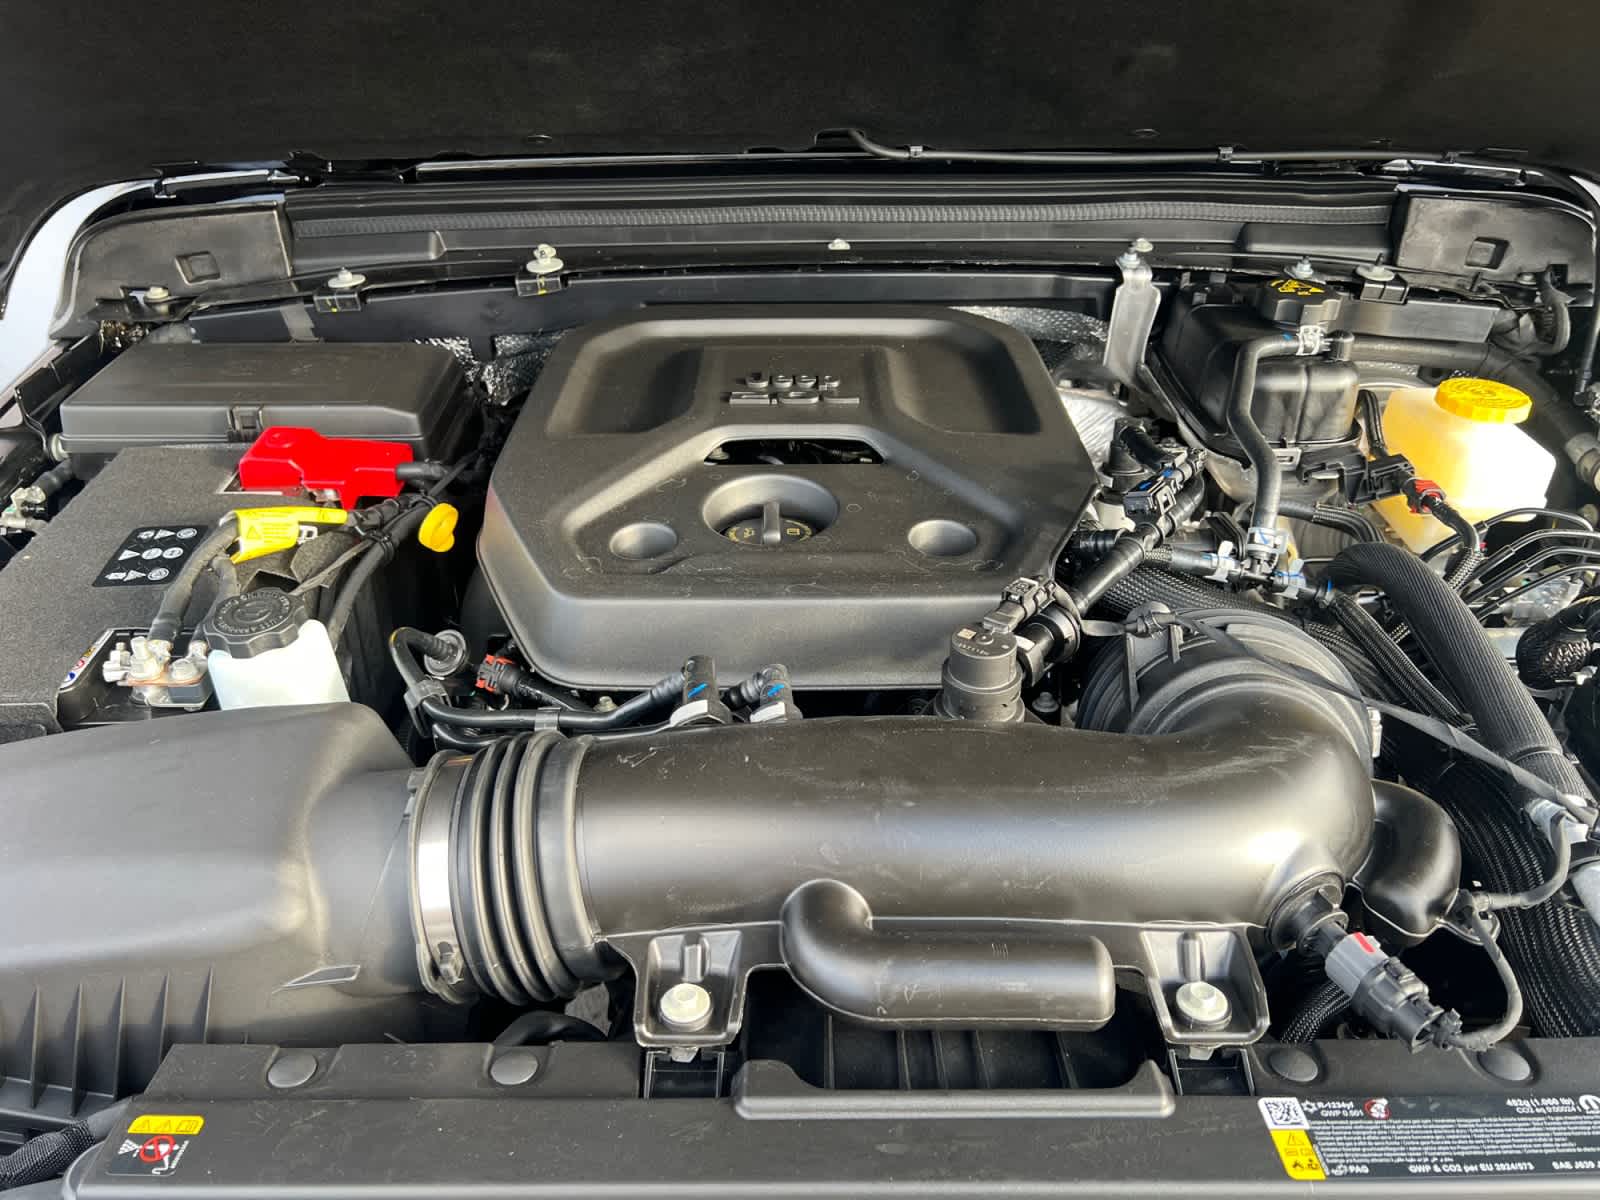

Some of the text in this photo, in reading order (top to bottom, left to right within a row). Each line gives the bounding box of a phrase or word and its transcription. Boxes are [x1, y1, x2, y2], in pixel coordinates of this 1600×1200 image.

[1442, 1163, 1463, 1173] CO2
[1479, 1162, 1494, 1172] EU
[1552, 1160, 1574, 1170] SAE
